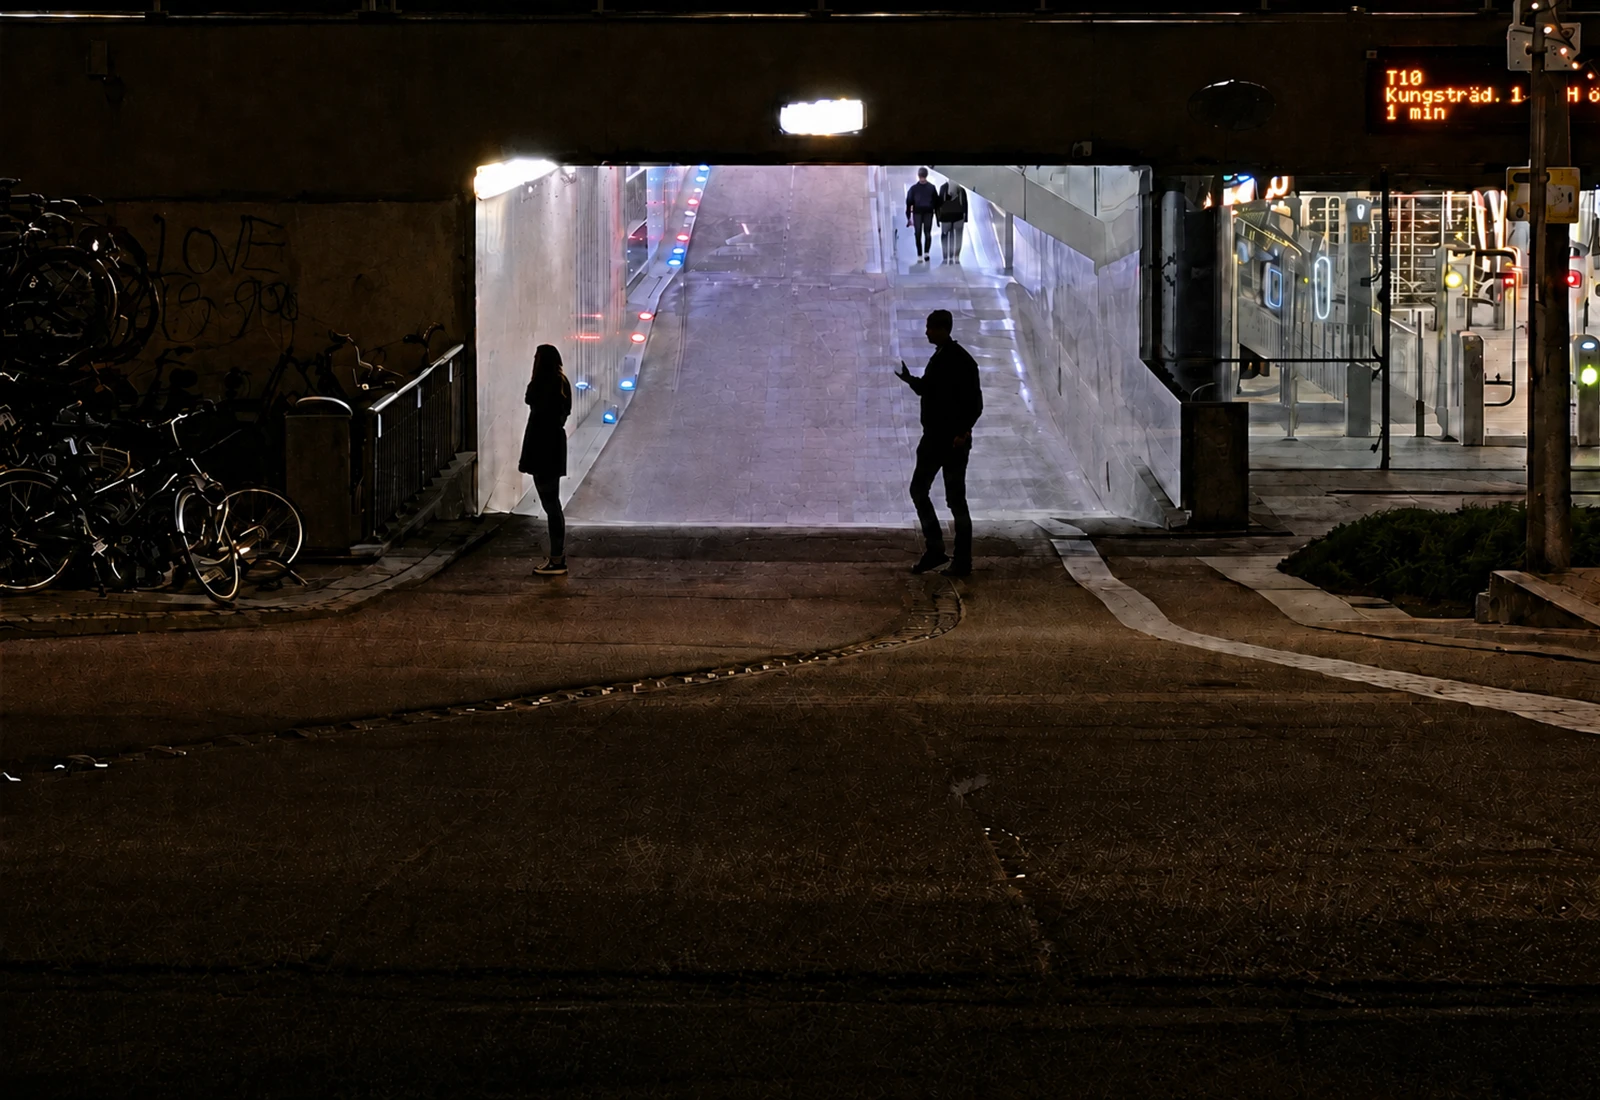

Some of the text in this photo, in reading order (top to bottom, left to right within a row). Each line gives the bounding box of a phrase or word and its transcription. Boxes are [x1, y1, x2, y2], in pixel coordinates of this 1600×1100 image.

[1386, 69, 1422, 86] T10
[1386, 86, 1500, 105] Kungsträd.
[1387, 103, 1446, 120] 1 min
[148, 213, 285, 278] LOVE
